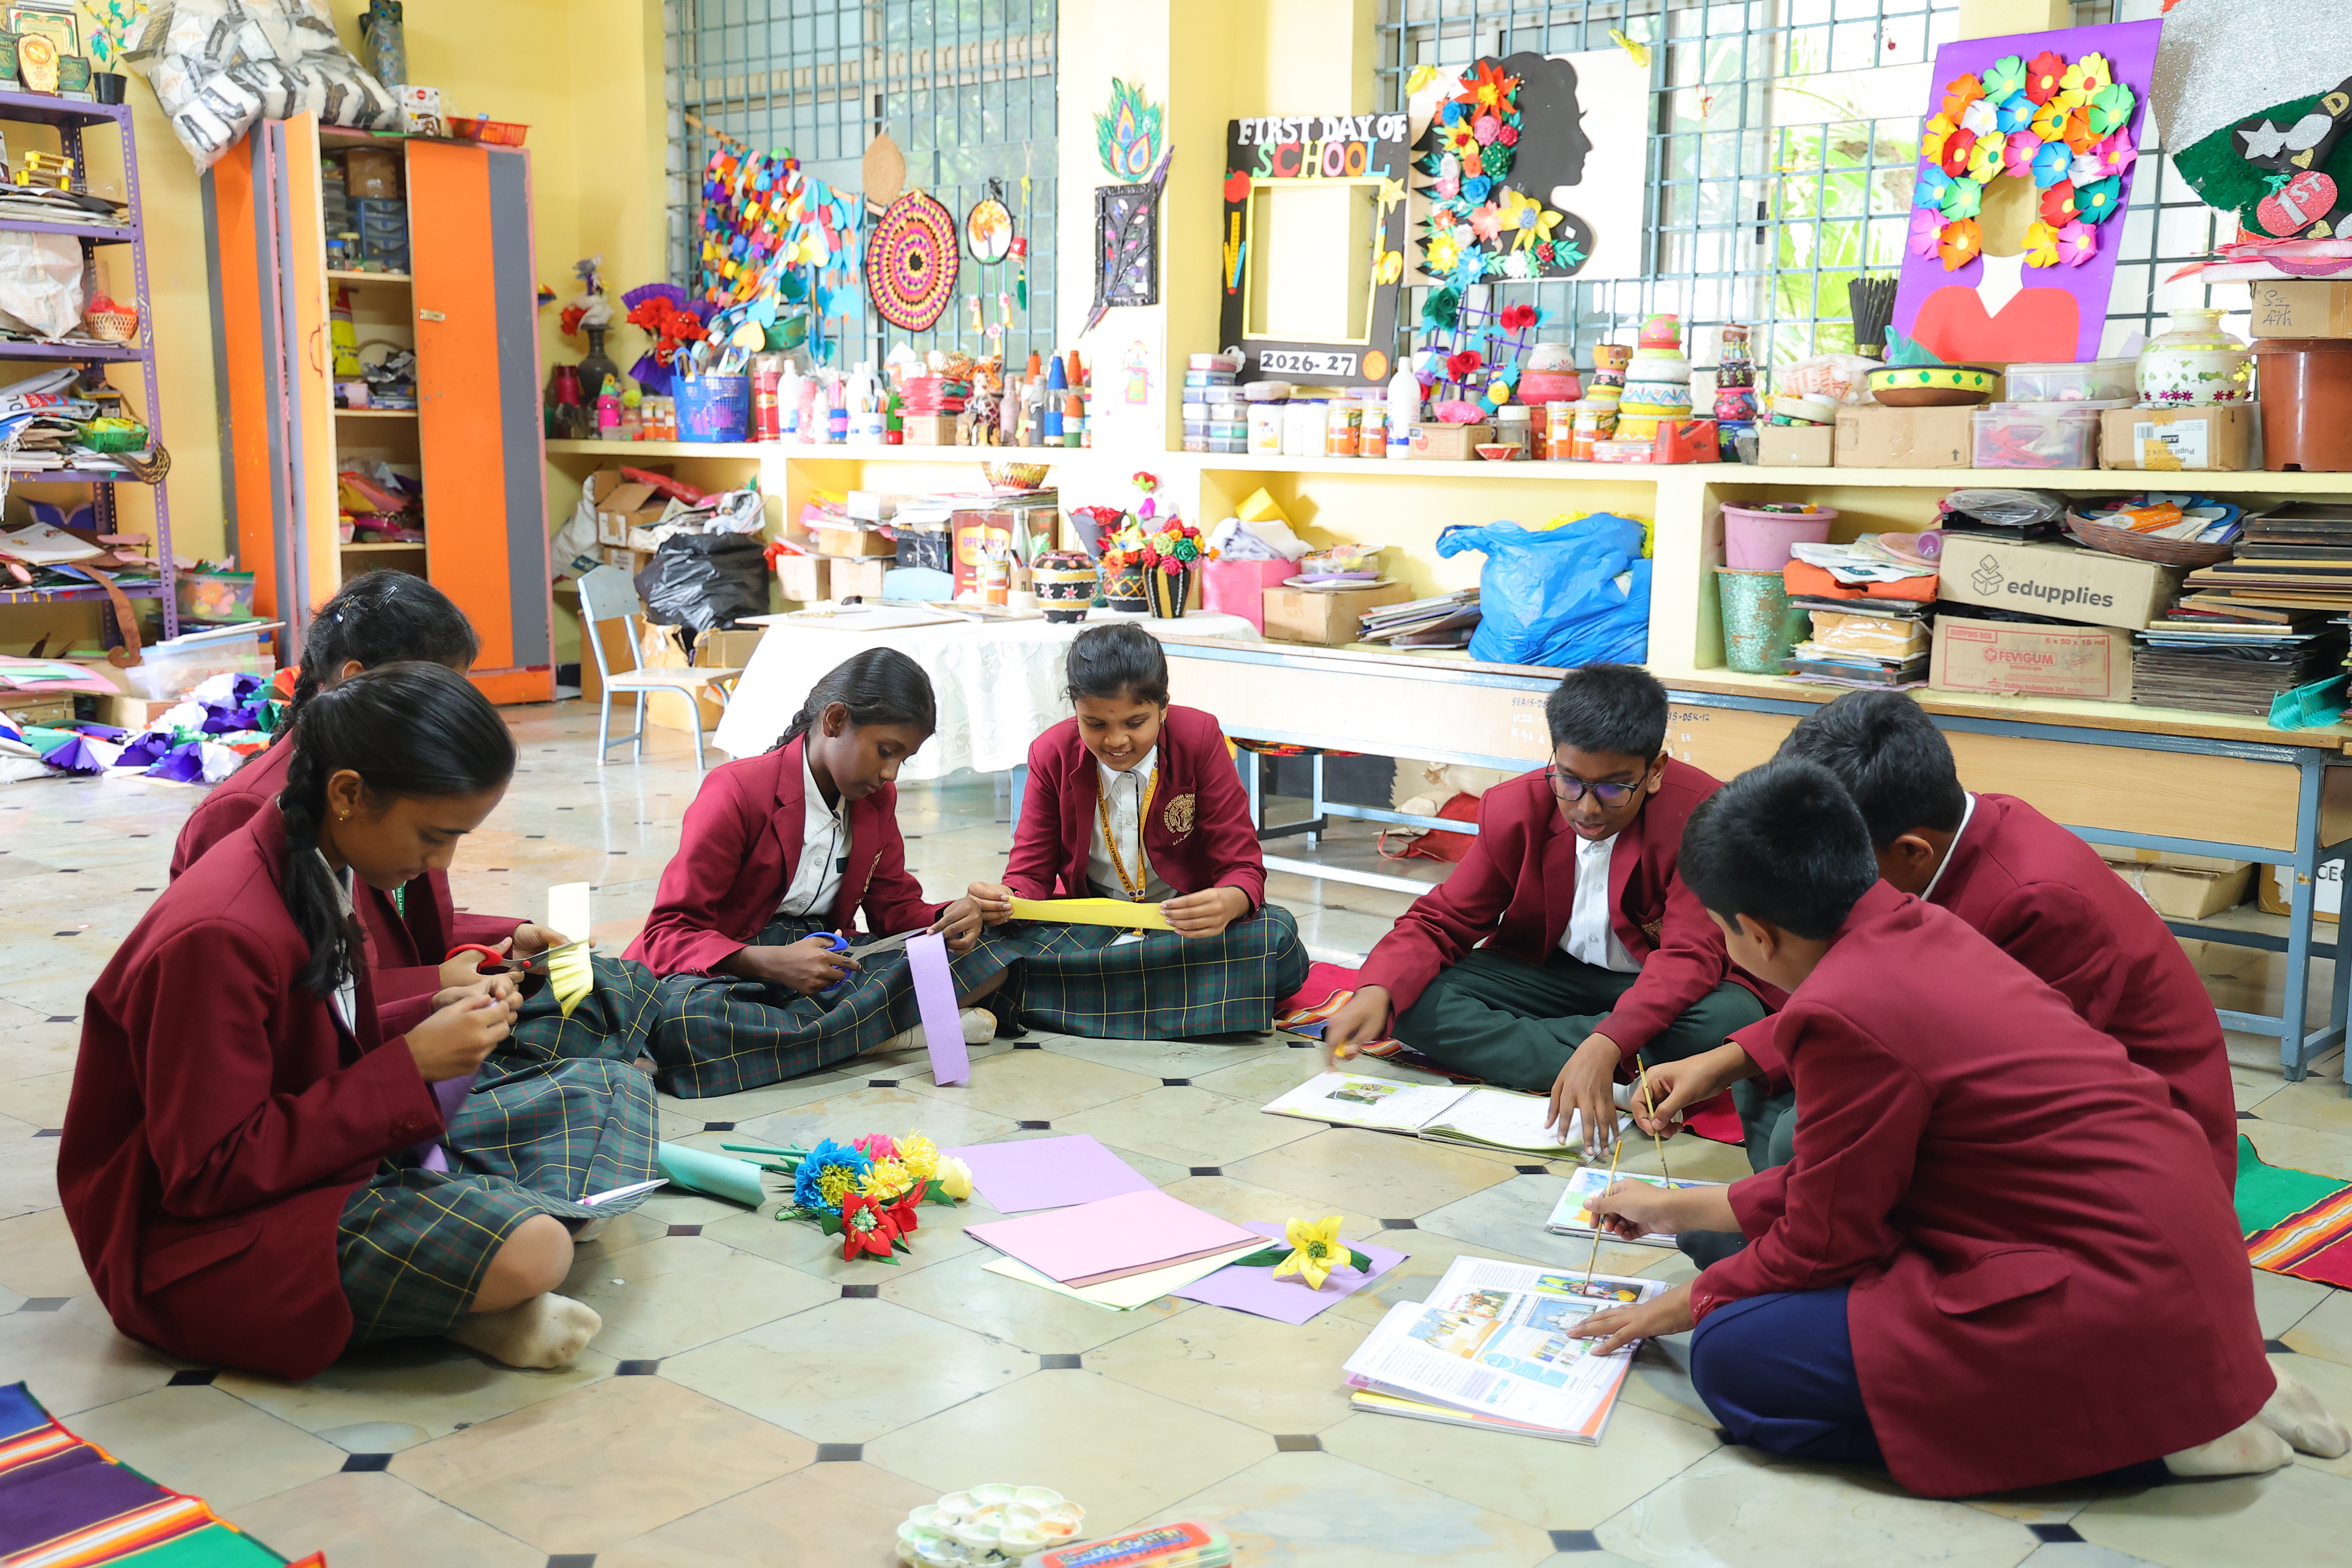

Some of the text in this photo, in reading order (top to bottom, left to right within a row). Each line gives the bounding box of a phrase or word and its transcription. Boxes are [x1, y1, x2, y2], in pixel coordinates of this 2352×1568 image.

[1237, 114, 1407, 145] FIRST DAY OF
[1253, 138, 1390, 177] SCHOOL
[2274, 172, 2323, 227] 1ST
[1326, 356, 1353, 376] 27
[2007, 580, 2113, 607] edupplies
[2000, 651, 2053, 664] FEVIGUM
[1100, 802, 1109, 828] SCHOOL
[1141, 799, 1150, 824] SCHOOL
[1165, 794, 1184, 811] THROUGH
[1164, 811, 1176, 833] PROGRESS
[1105, 830, 1124, 874] INTERNATIONAL
